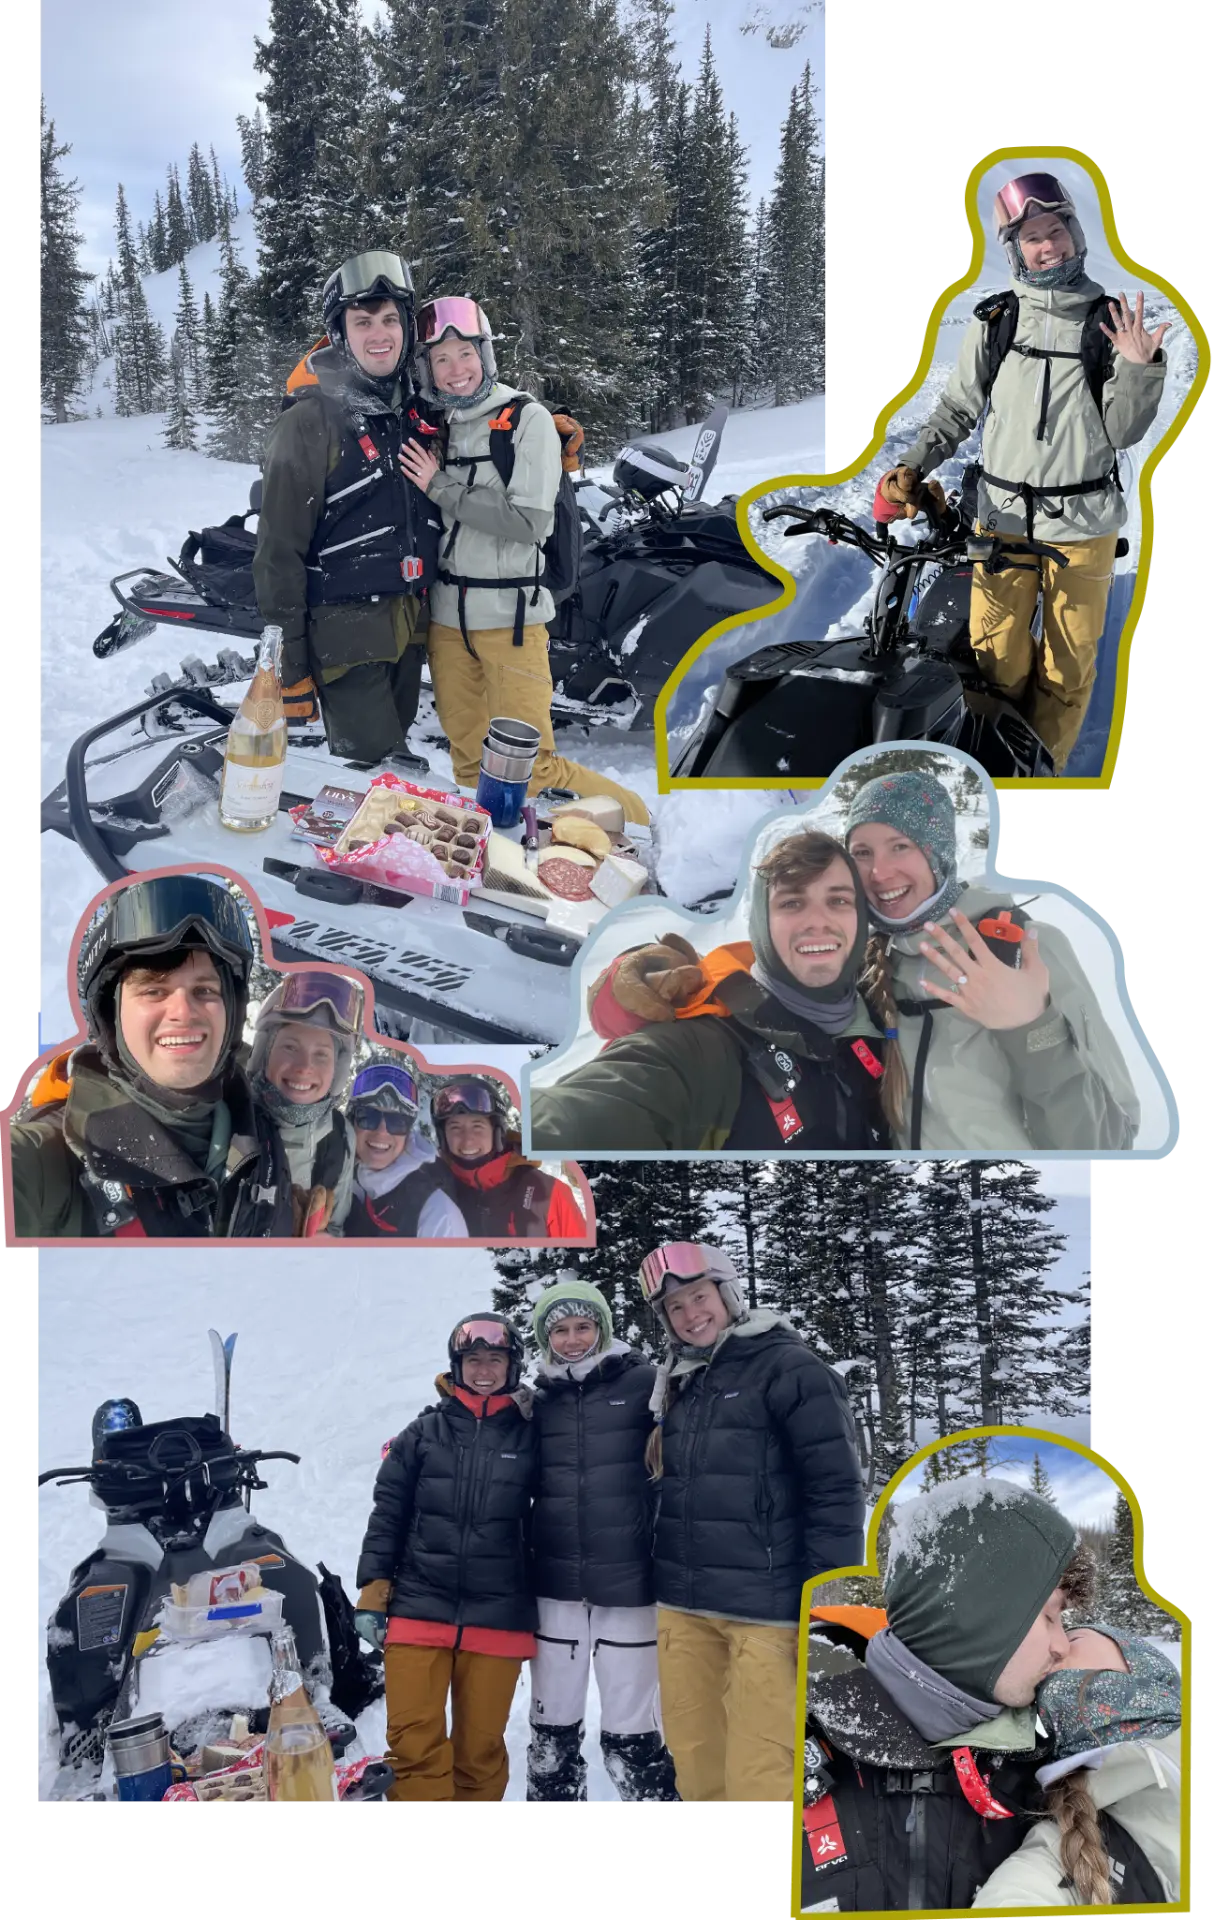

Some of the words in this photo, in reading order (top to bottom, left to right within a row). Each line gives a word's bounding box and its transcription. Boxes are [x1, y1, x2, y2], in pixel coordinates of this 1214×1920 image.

[325, 790, 356, 803] LILY'S
[776, 1054, 791, 1071] bca
[815, 1855, 849, 1873] arva
